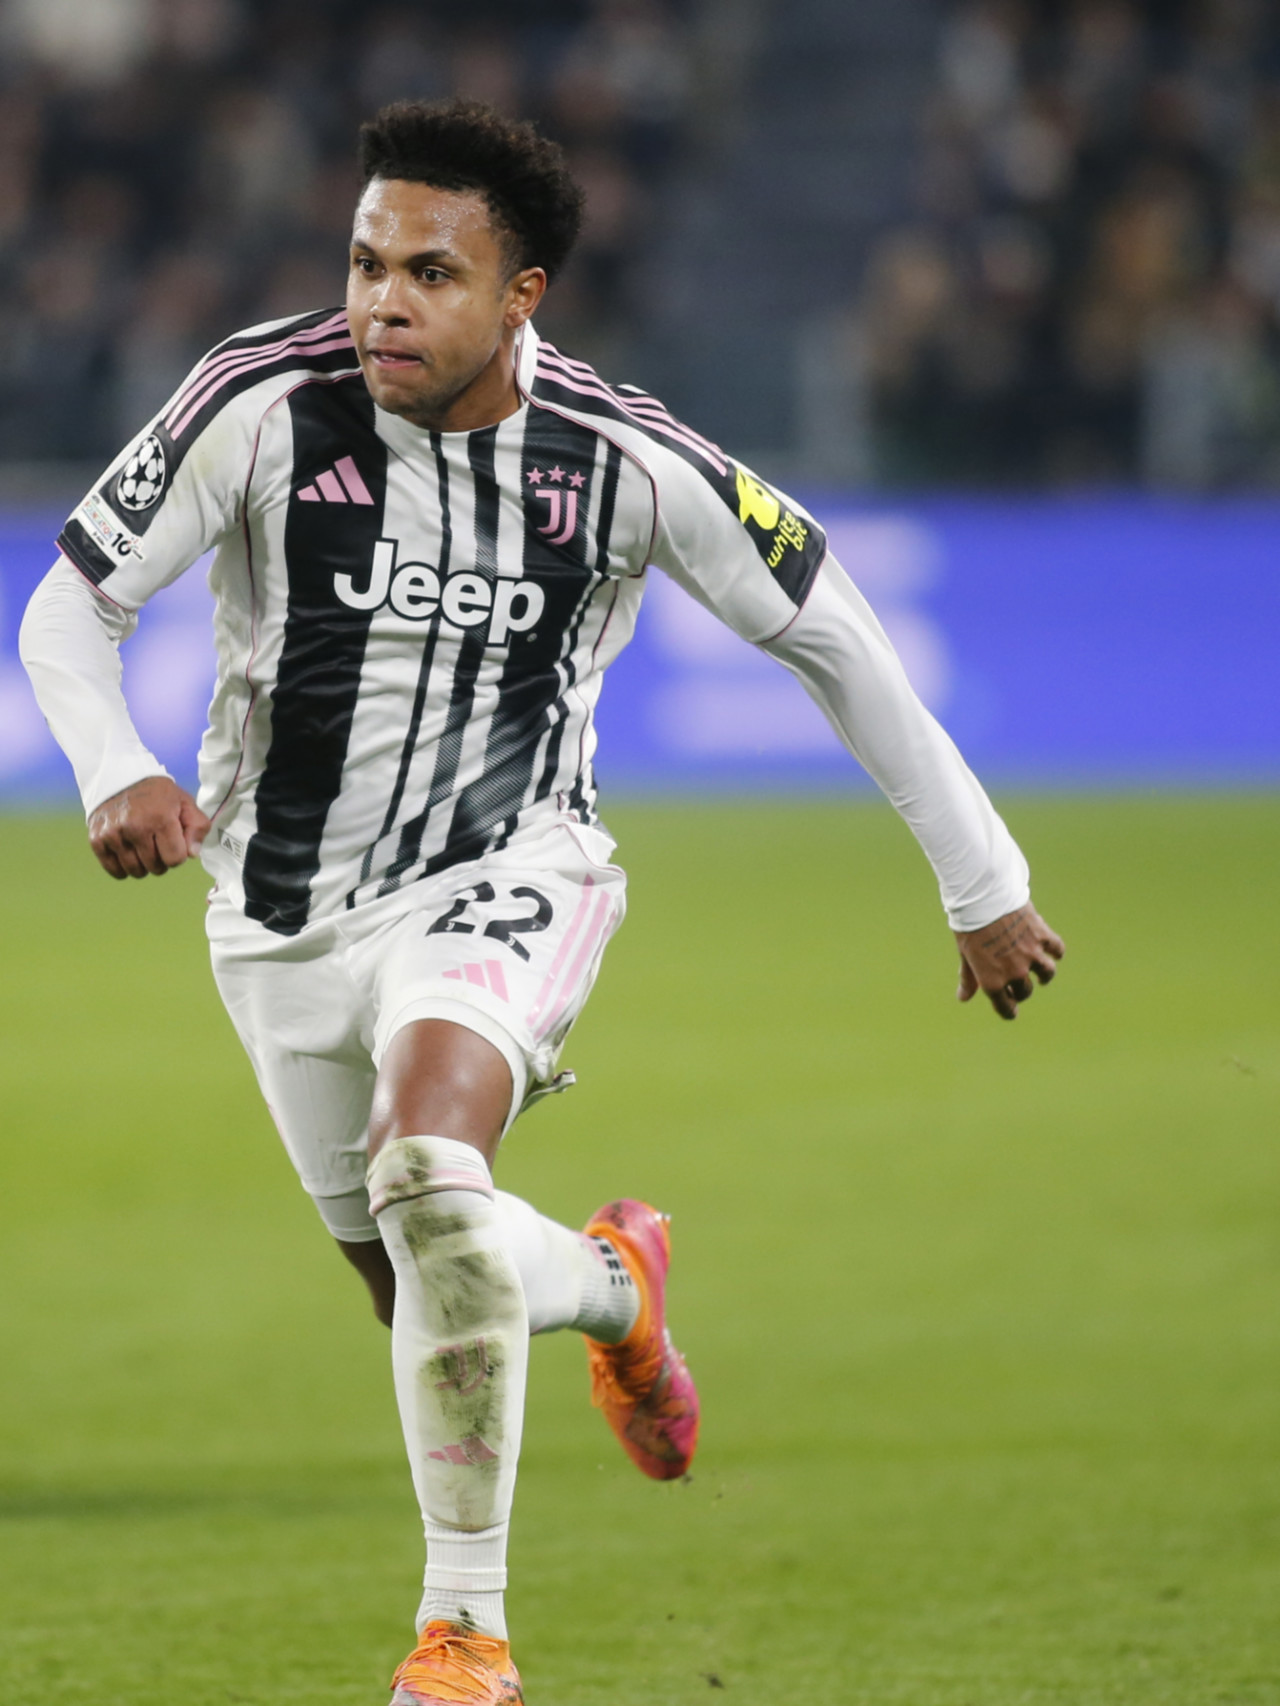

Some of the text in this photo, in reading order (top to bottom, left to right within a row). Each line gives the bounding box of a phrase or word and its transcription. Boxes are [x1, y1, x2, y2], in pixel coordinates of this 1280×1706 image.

[767, 510, 796, 568] white
[790, 521, 808, 552] bit
[334, 541, 545, 643] Jeep
[425, 881, 553, 962] 22
